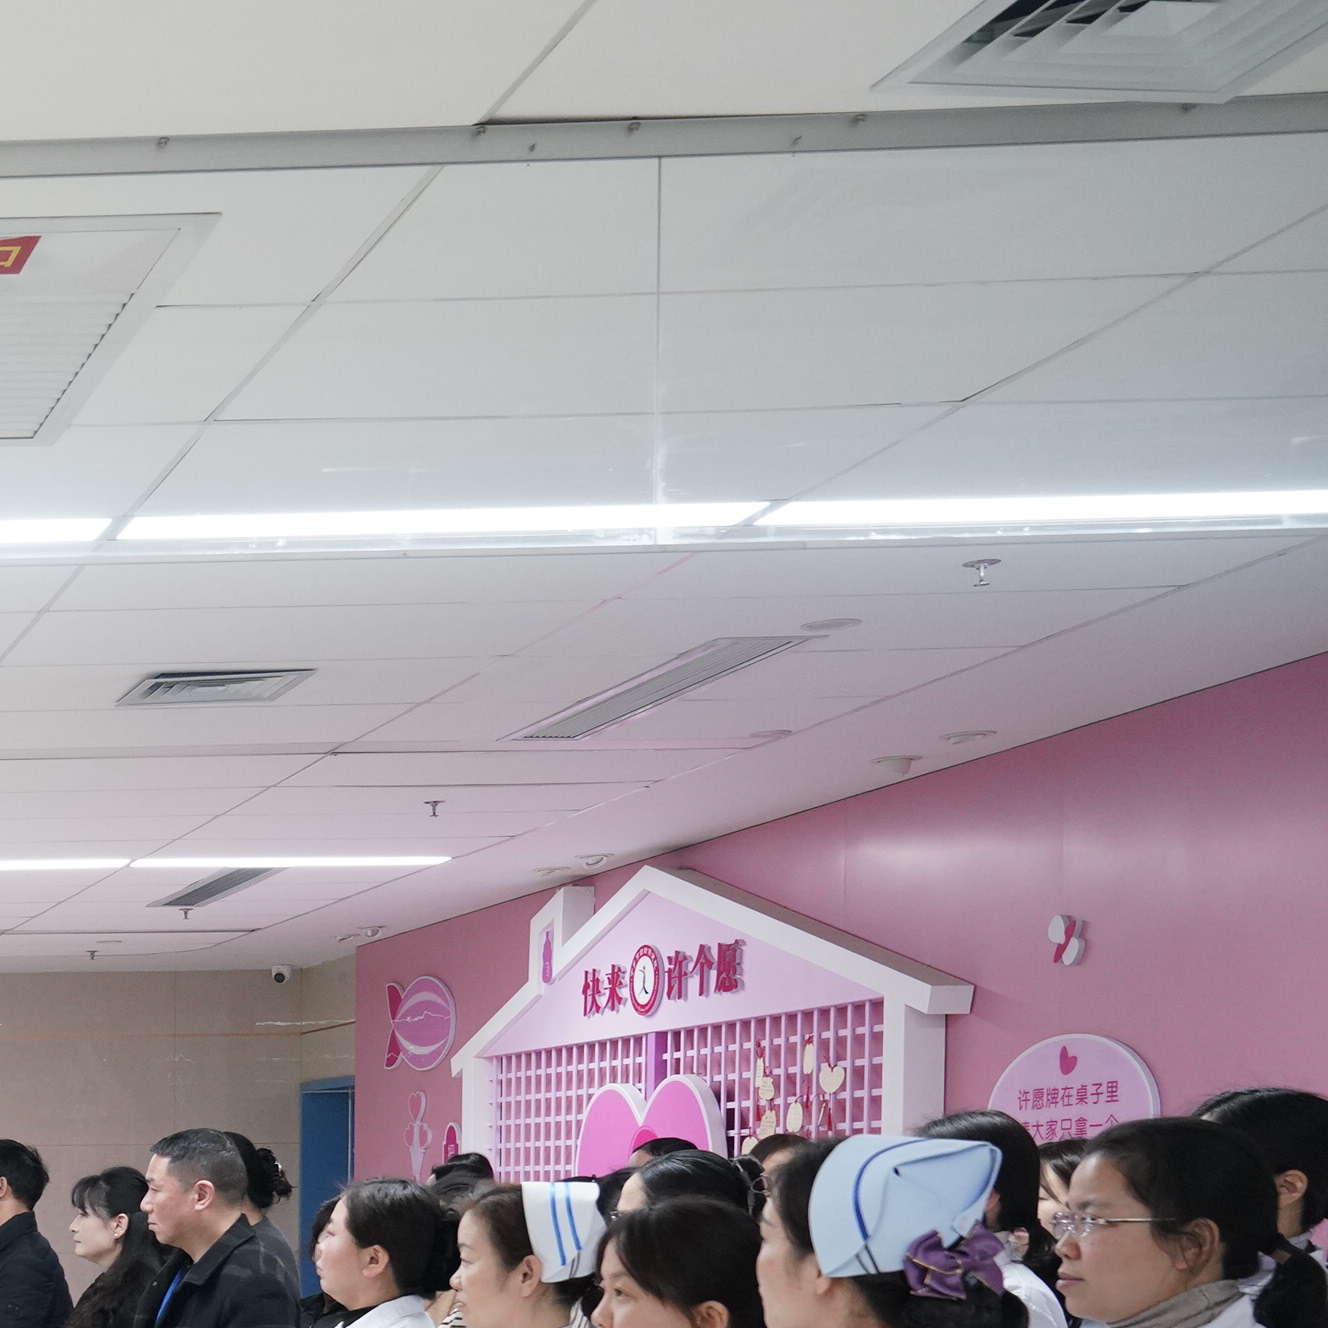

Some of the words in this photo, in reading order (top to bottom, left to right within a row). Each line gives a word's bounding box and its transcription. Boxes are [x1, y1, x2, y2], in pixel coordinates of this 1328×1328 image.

[582, 964, 625, 1017] 快来
[665, 940, 746, 1001] 许个愿
[1018, 1080, 1119, 1111] 许愿牌在桌子里
